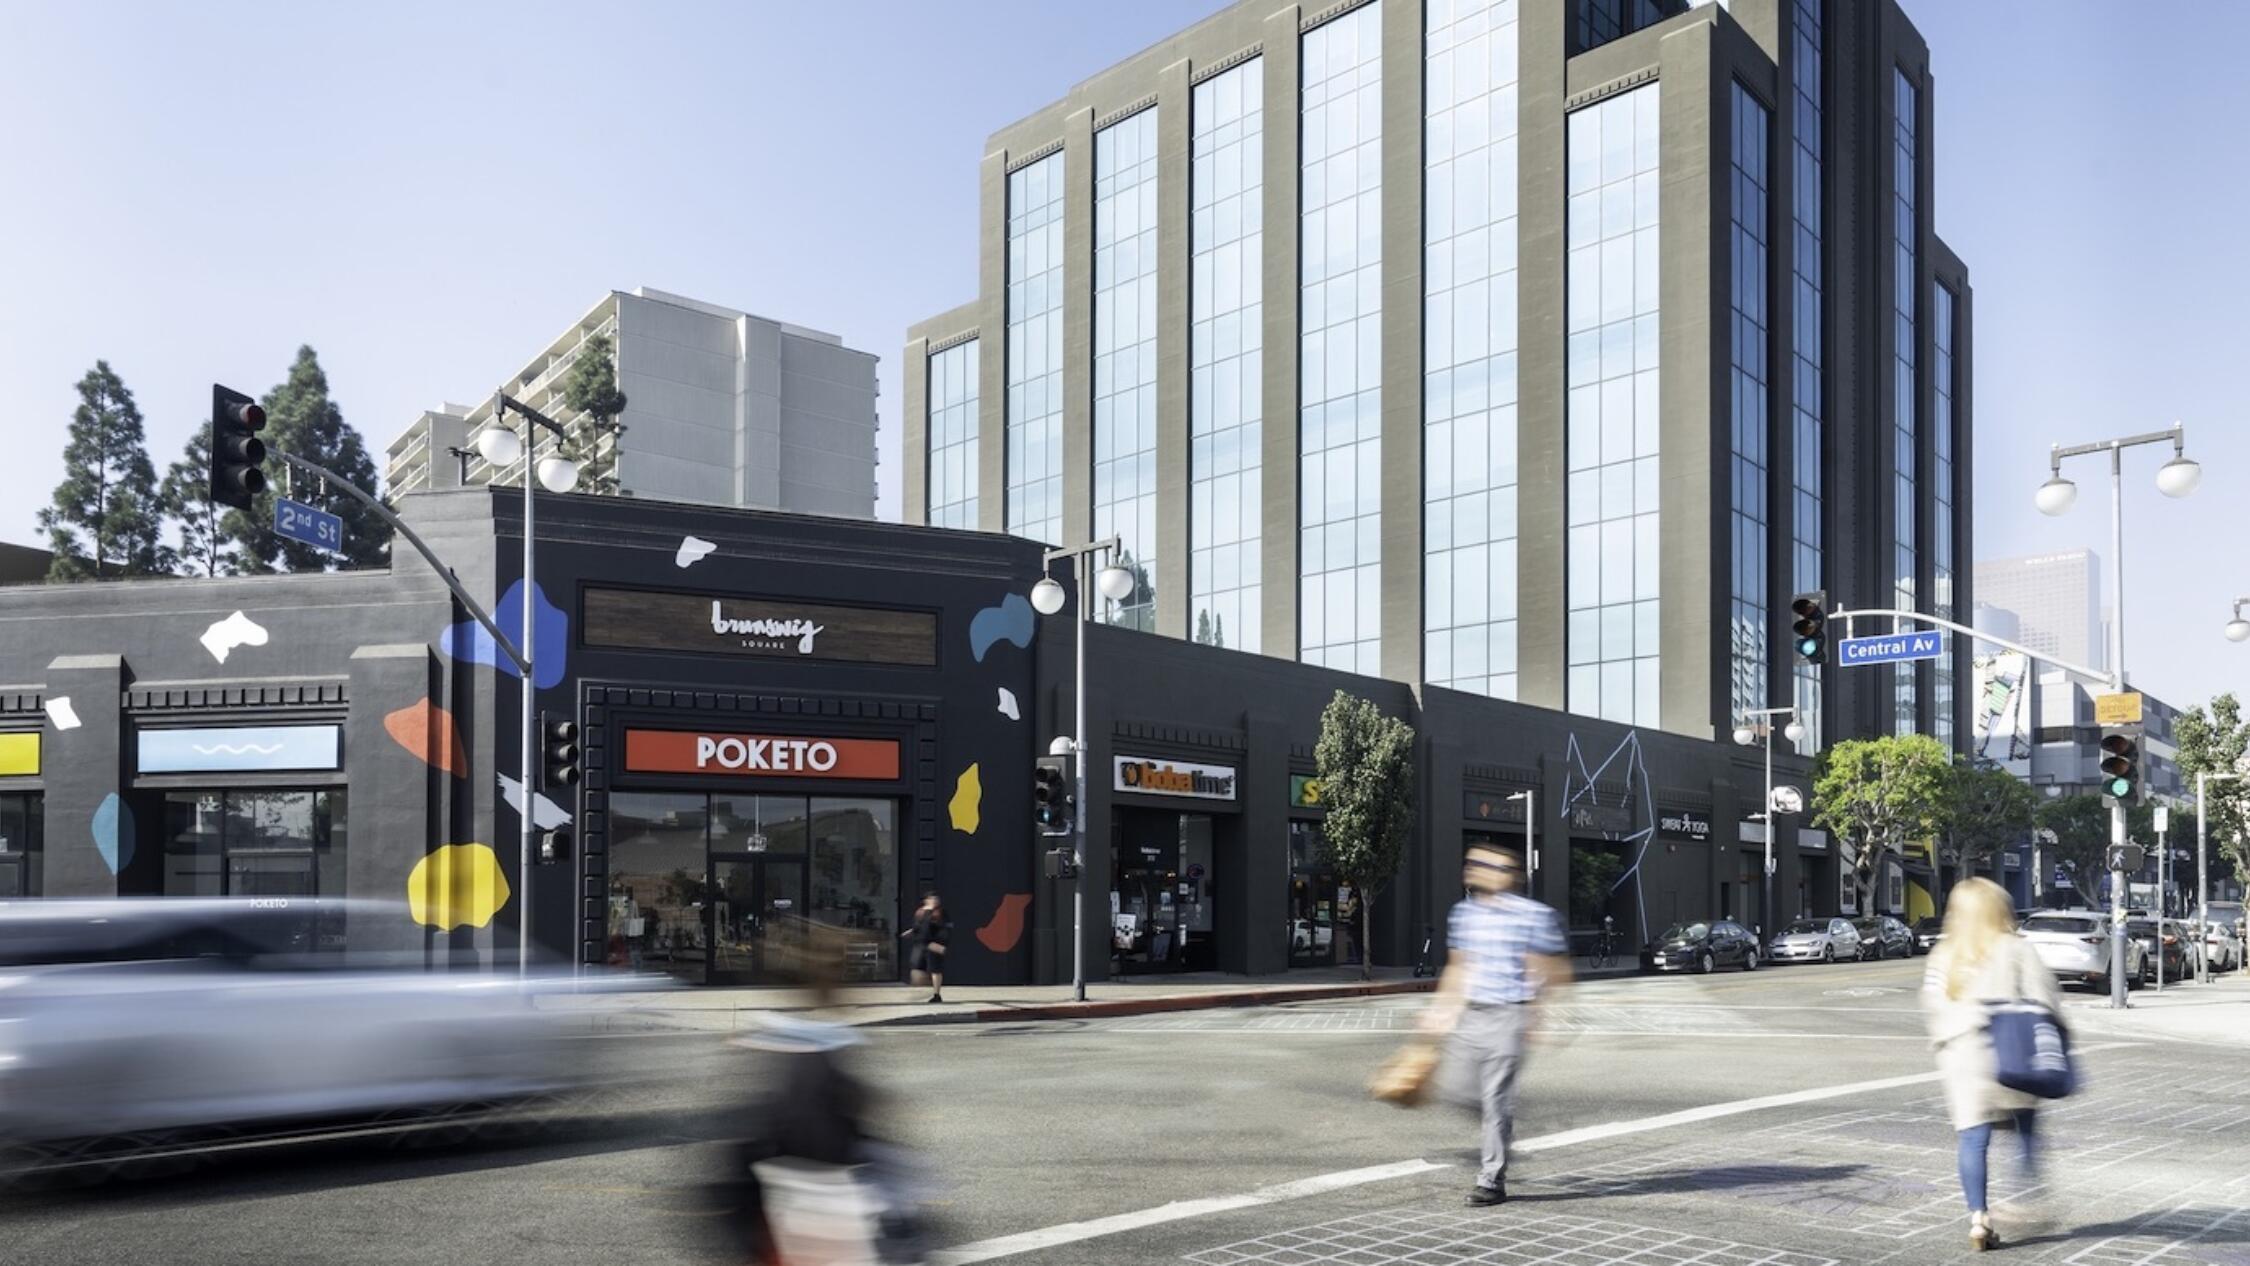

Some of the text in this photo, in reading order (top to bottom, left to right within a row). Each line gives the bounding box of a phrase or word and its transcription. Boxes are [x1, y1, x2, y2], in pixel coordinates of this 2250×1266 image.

[281, 507, 336, 542] 2nd St
[742, 640, 785, 650] SQUARE
[1848, 638, 1934, 658] Central Av
[697, 736, 838, 772] POKETO
